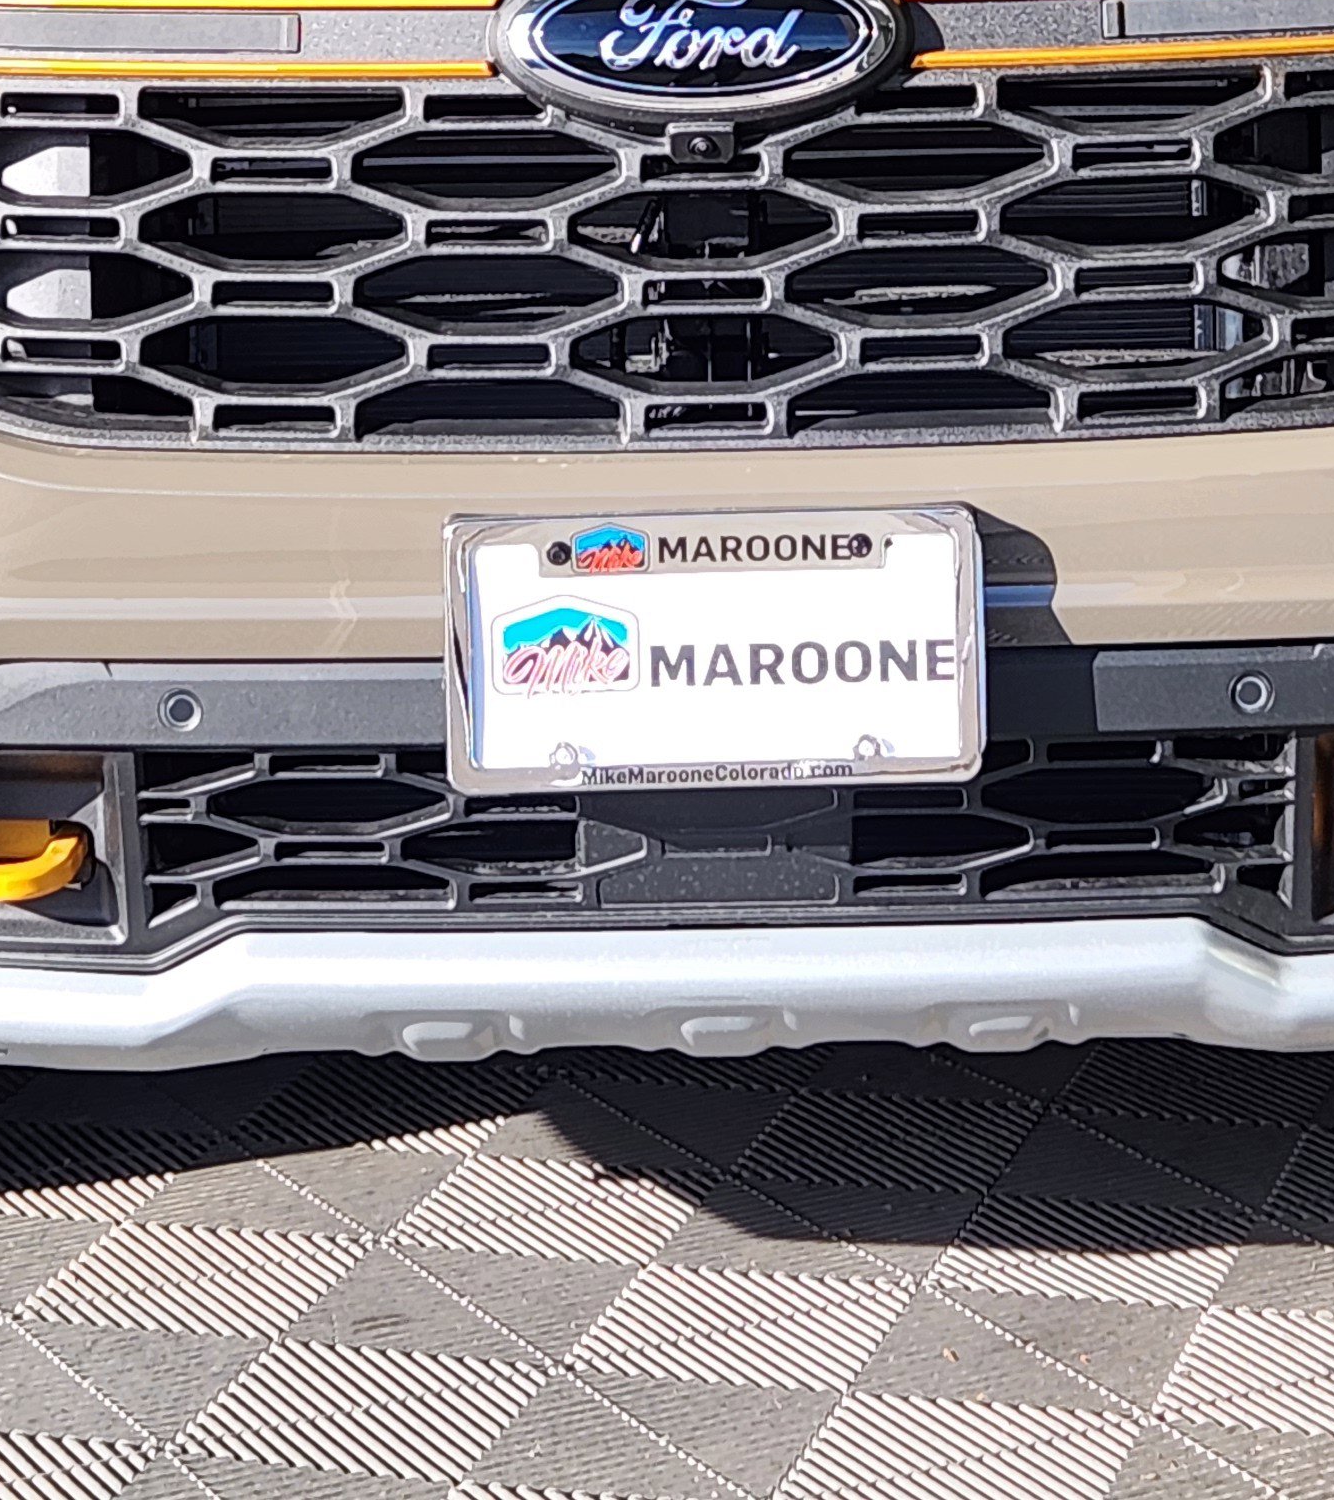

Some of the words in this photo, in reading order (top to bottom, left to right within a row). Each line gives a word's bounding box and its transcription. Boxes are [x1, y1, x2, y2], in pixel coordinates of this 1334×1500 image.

[657, 533, 854, 563] MAROONE
[503, 638, 628, 699] Mike
[649, 639, 955, 687] MAROONE
